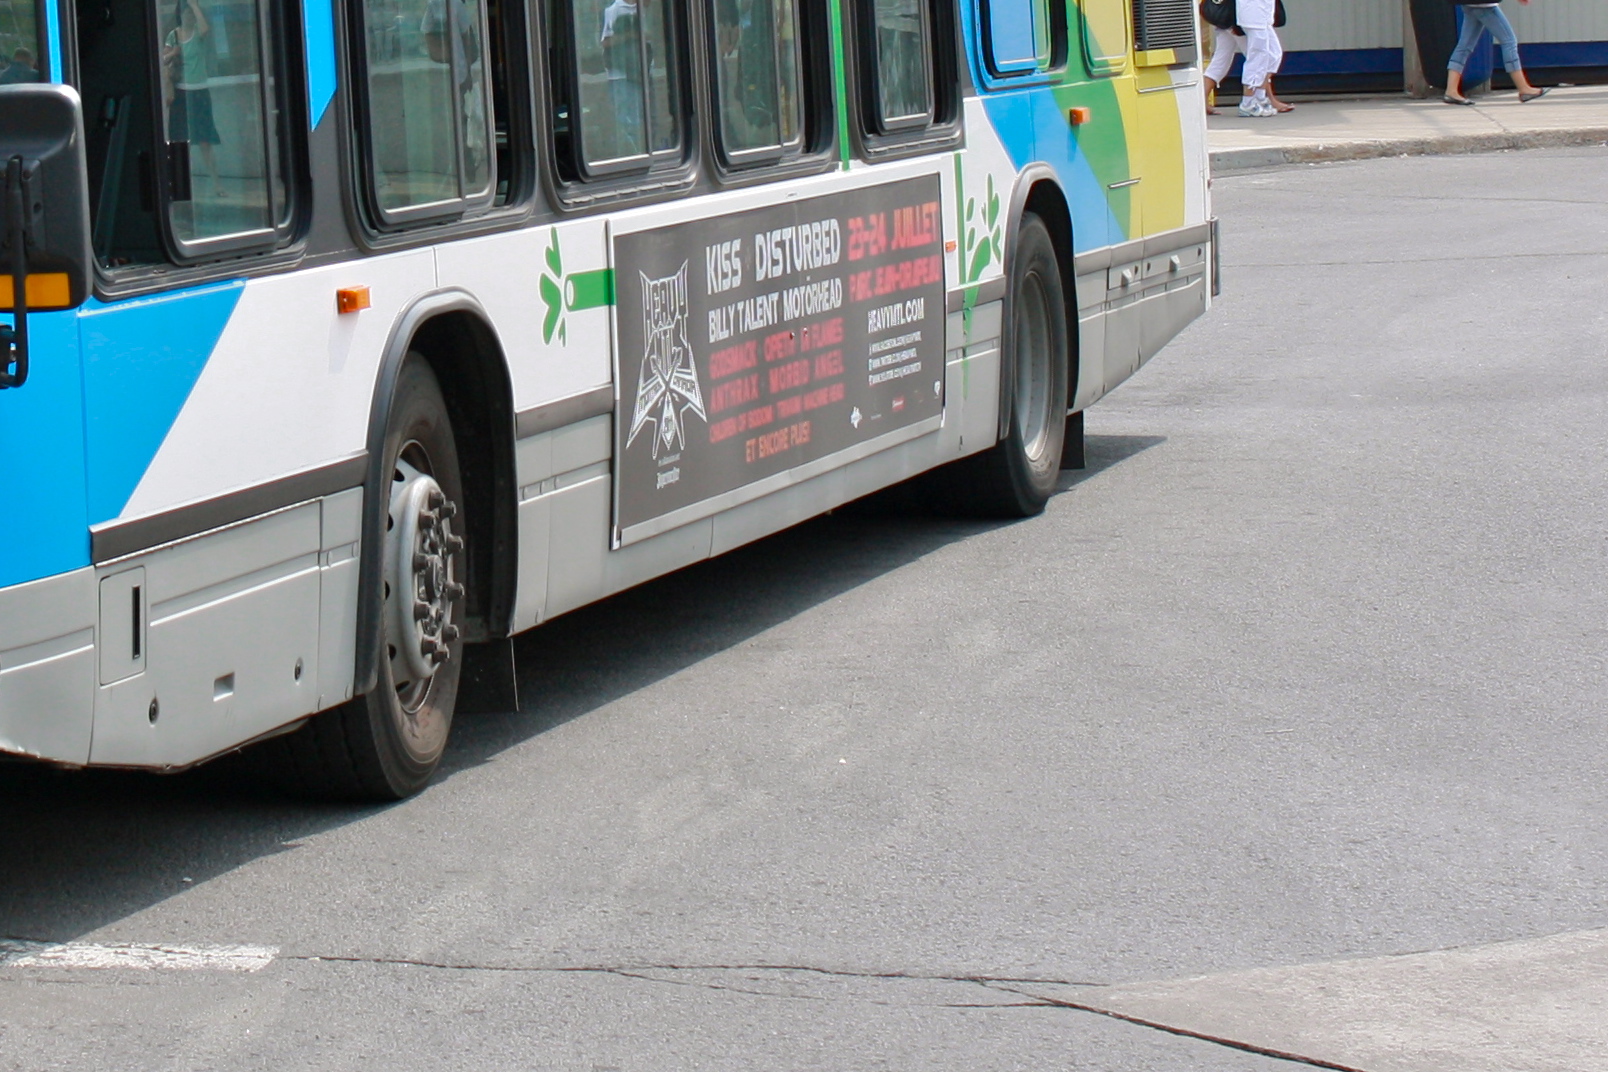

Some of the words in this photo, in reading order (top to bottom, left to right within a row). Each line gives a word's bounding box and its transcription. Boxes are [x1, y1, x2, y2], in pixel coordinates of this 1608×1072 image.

[891, 201, 938, 250] JUILLET
[706, 238, 742, 295] KISS
[755, 218, 841, 282] DISTURBED
[708, 303, 735, 344] BILLY
[737, 292, 780, 334] TALENT
[867, 297, 924, 334] HEAVYMTL.COM
